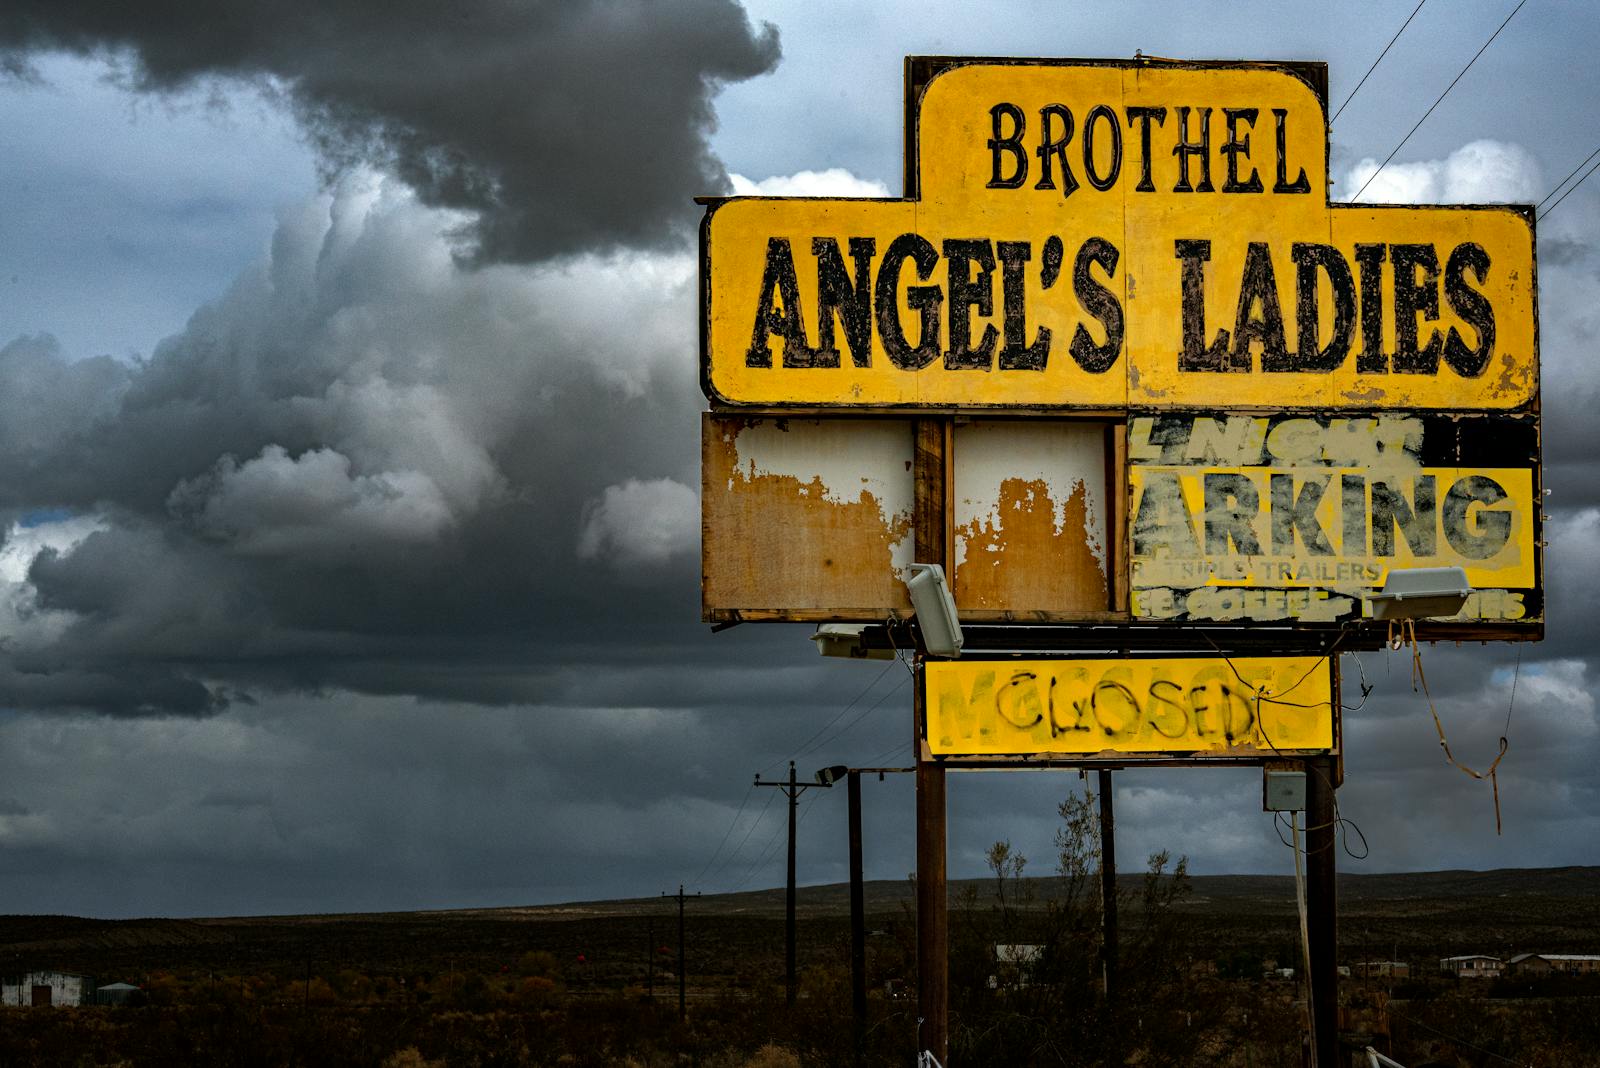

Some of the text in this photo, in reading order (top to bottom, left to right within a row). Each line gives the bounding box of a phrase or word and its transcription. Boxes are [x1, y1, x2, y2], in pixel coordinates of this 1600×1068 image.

[985, 102, 1311, 198] BROTHEL
[745, 232, 1497, 378] ANGEL'S LADIES
[1259, 561, 1383, 582] TRAILERS
[996, 672, 1256, 742] CLOSED
